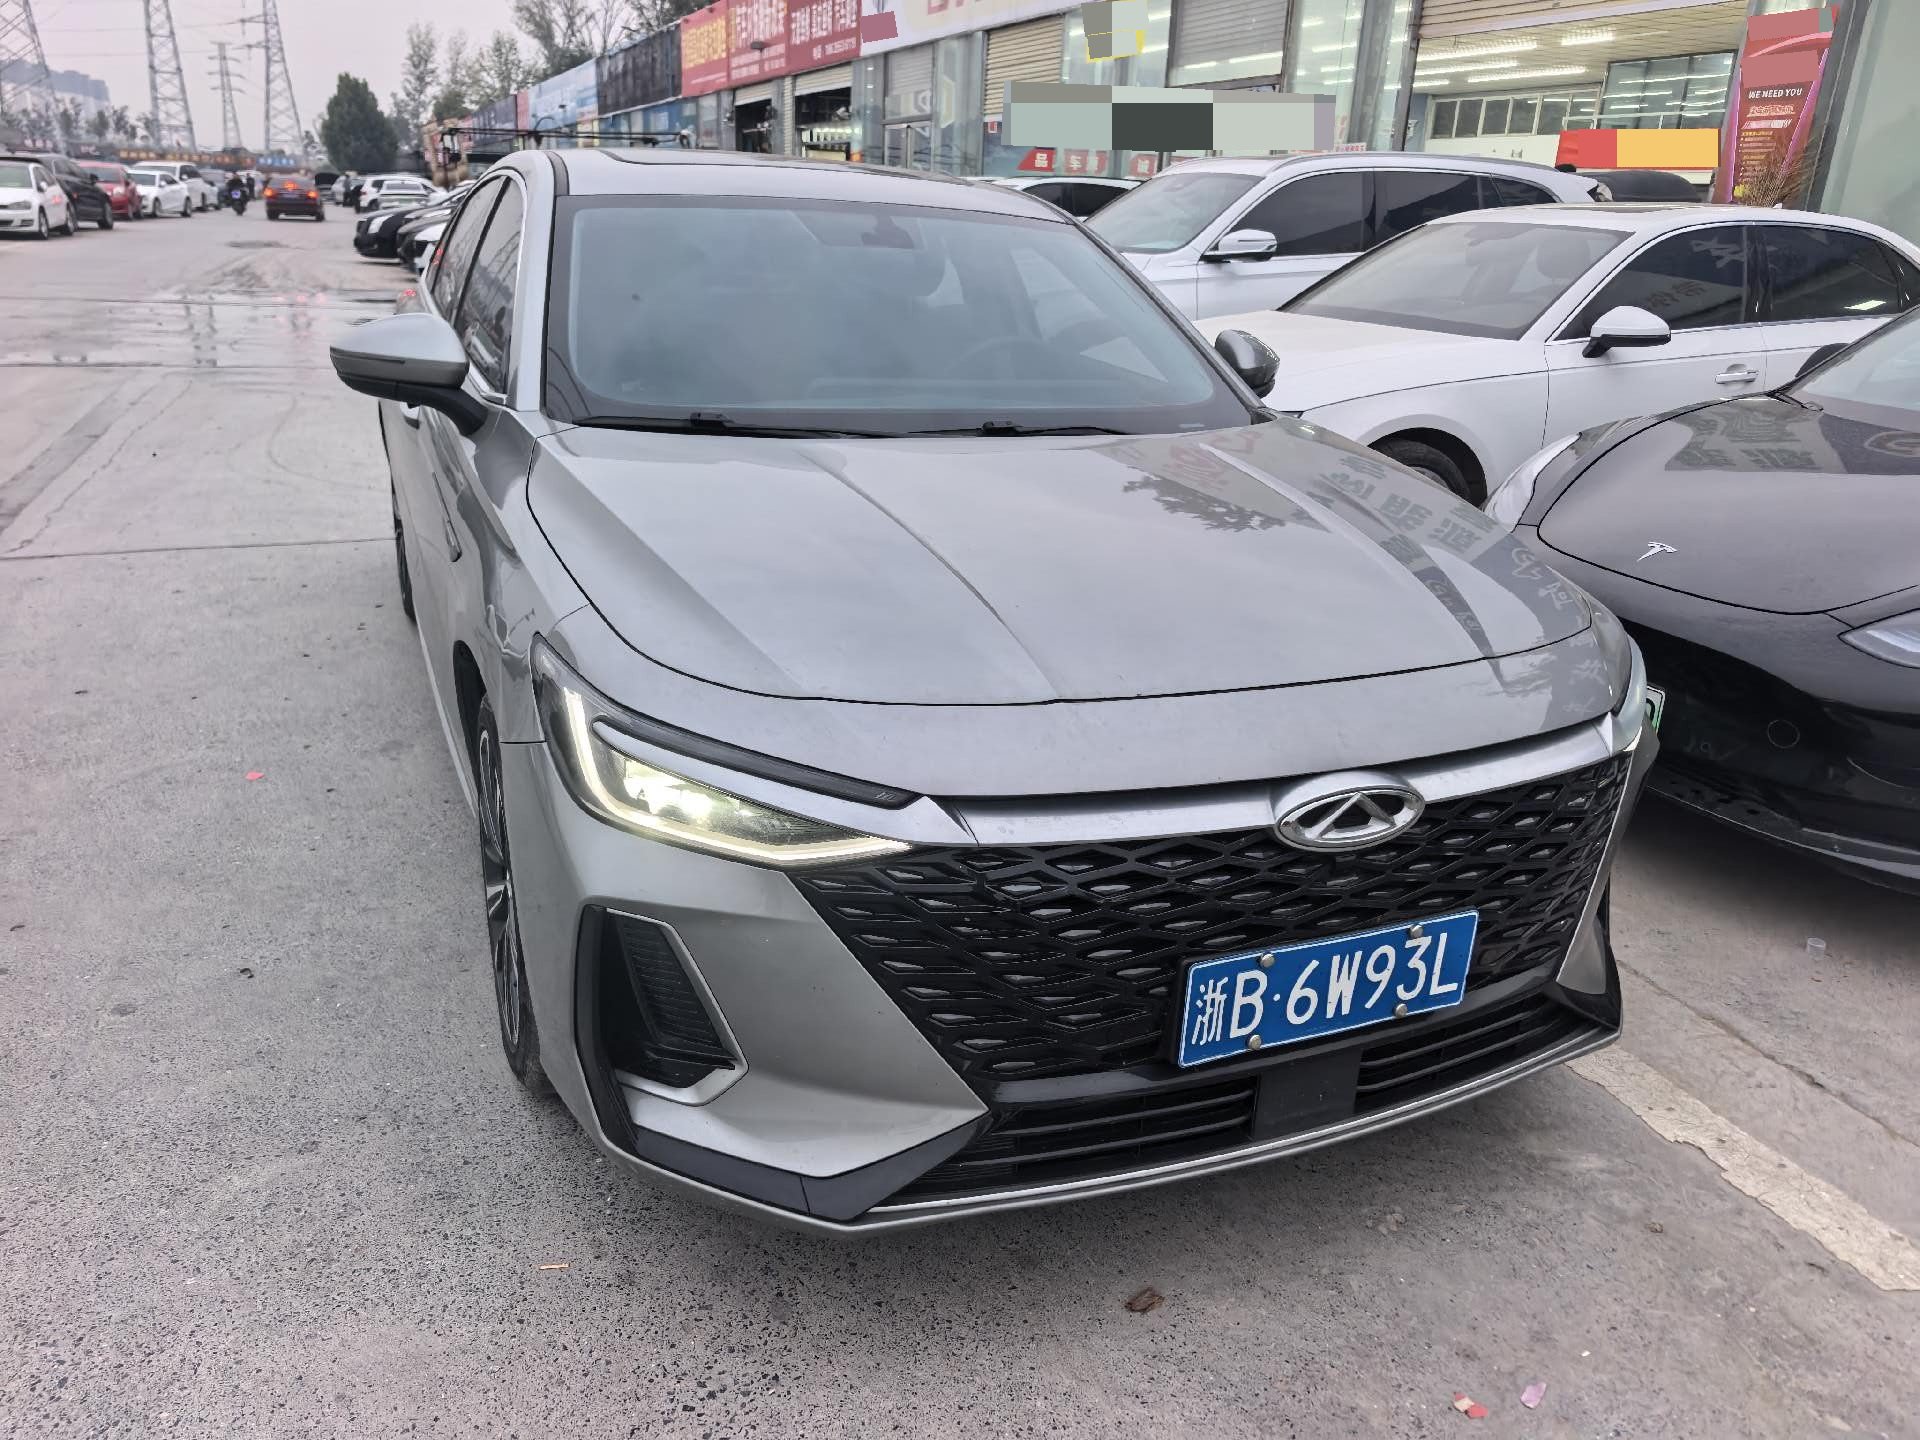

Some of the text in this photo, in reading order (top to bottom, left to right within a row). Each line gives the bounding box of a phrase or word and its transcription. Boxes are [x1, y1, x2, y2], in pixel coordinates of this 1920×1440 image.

[1748, 88, 1803, 99] WE NEED YOU
[1191, 932, 1459, 1046] 浙B·6W93L
